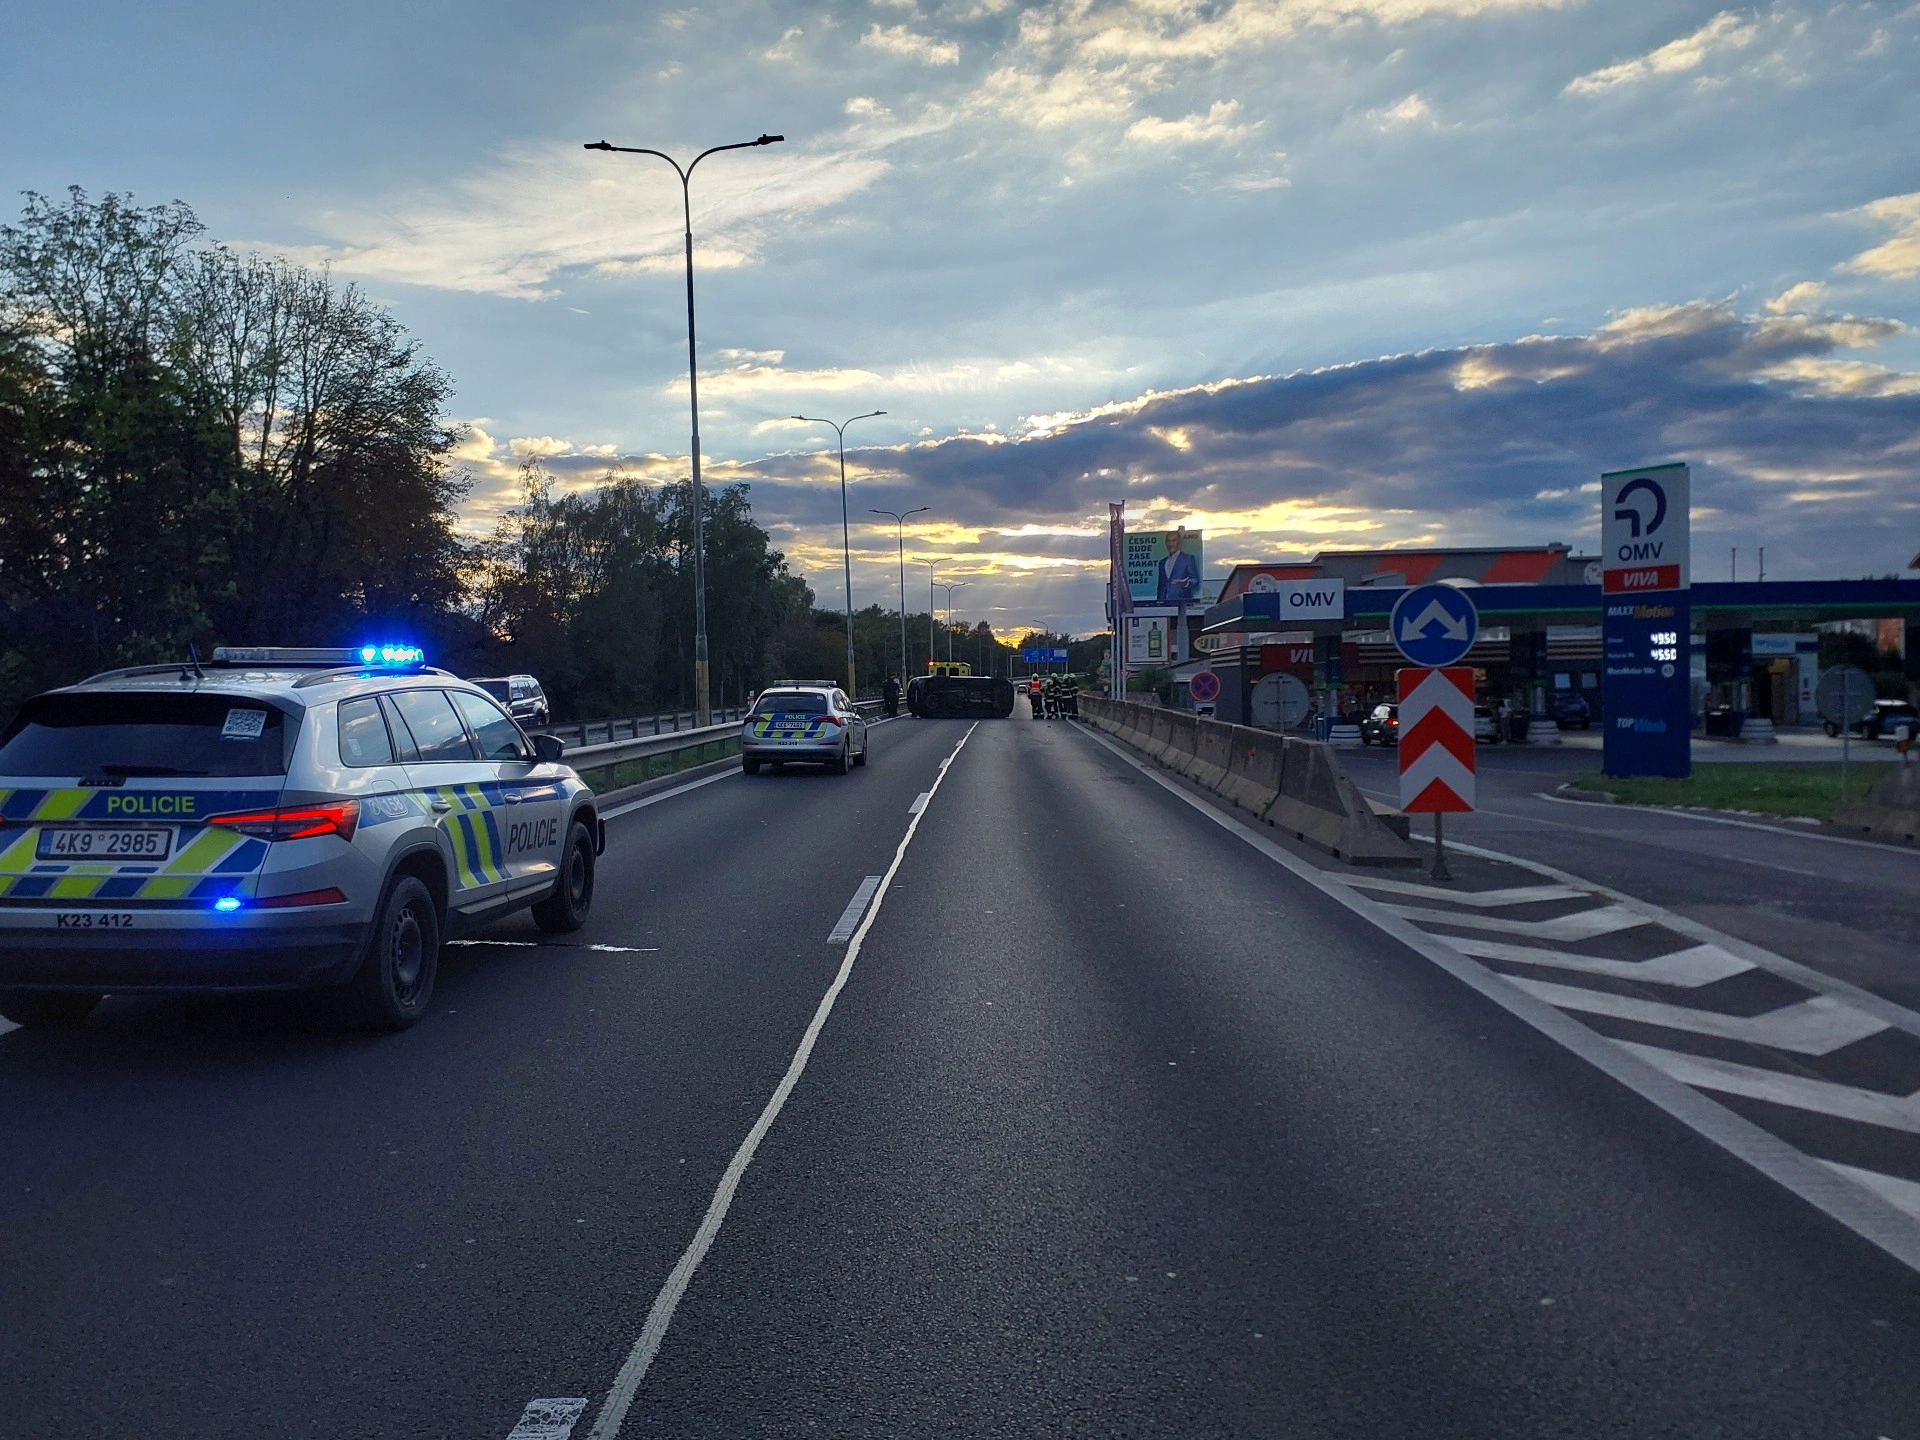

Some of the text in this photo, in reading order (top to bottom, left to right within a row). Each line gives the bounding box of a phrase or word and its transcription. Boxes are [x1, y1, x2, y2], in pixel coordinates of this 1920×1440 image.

[1128, 536, 1157, 545] ČESKO
[1618, 542, 1663, 561] OMV
[1128, 560, 1158, 568] MAKAT
[1624, 571, 1659, 587] VIVA
[1289, 591, 1336, 607] OMV
[107, 796, 196, 814] POLICIE
[382, 797, 404, 813] 158
[56, 833, 159, 853] 4K9 2985
[508, 818, 557, 855] POLICIE
[57, 914, 133, 928] K23 412
